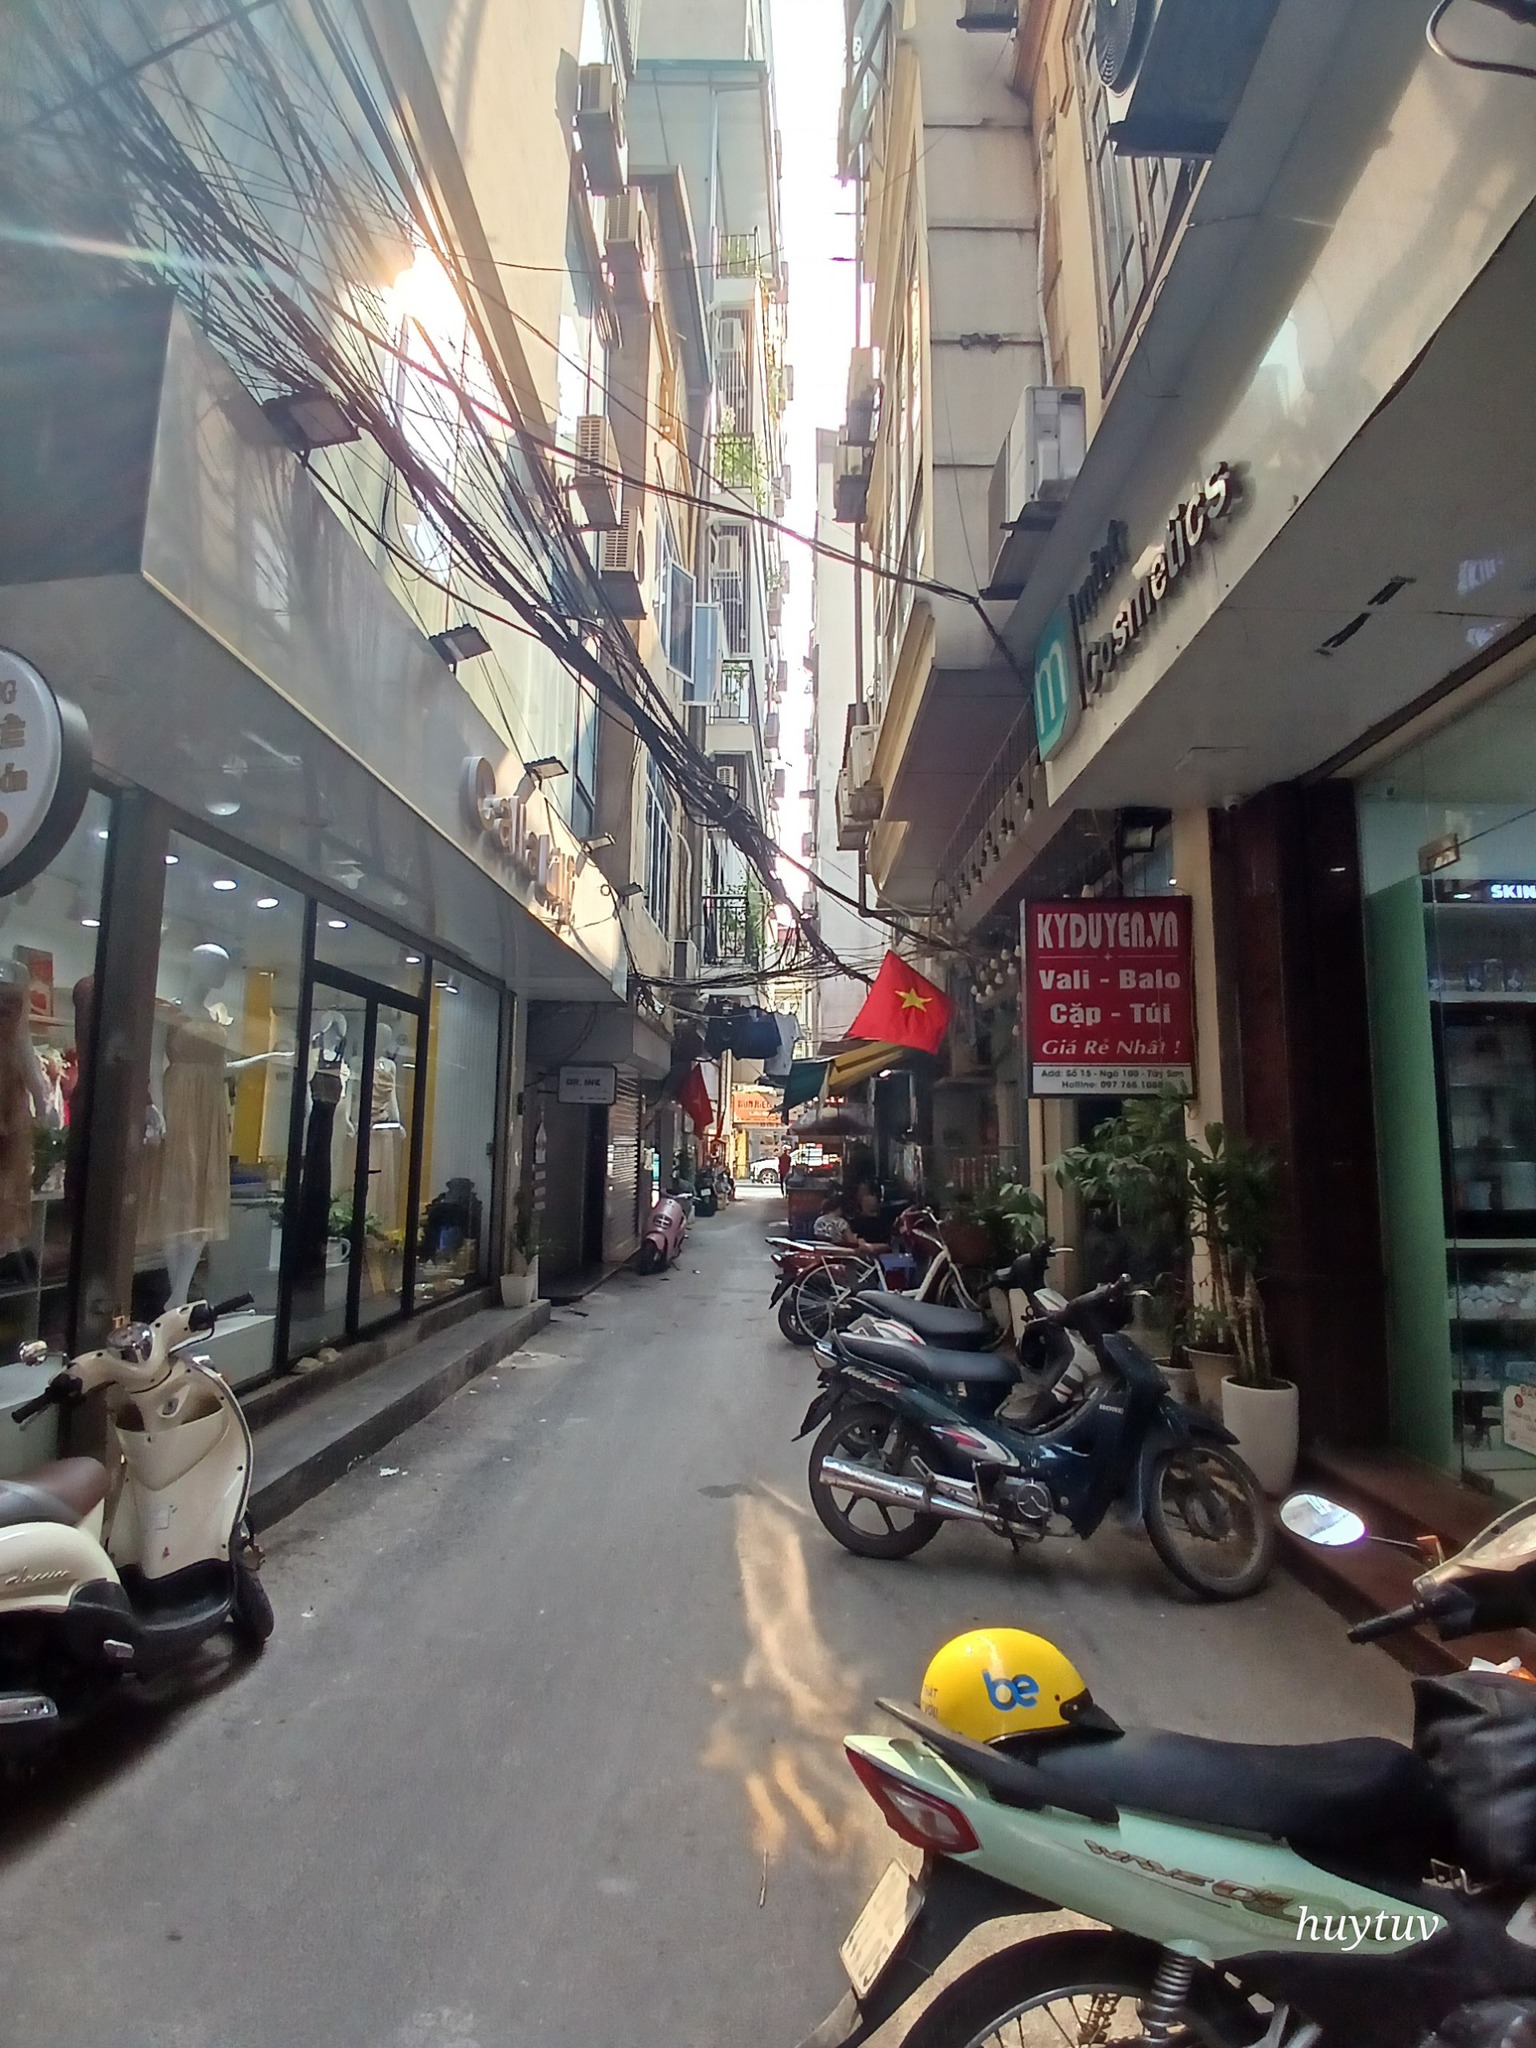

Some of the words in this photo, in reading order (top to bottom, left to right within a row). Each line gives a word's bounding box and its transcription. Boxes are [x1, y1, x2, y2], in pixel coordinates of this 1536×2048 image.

[1039, 969, 1090, 990] Vali
[1119, 969, 1180, 989] Balo
[1050, 1003, 1101, 1028] Cặp
[1130, 1003, 1171, 1023] Túi
[1042, 1039, 1076, 1055] Giá
[1084, 1038, 1109, 1055] Rẻ
[1116, 1037, 1165, 1055] Nhất
[982, 1668, 1040, 1713] be
